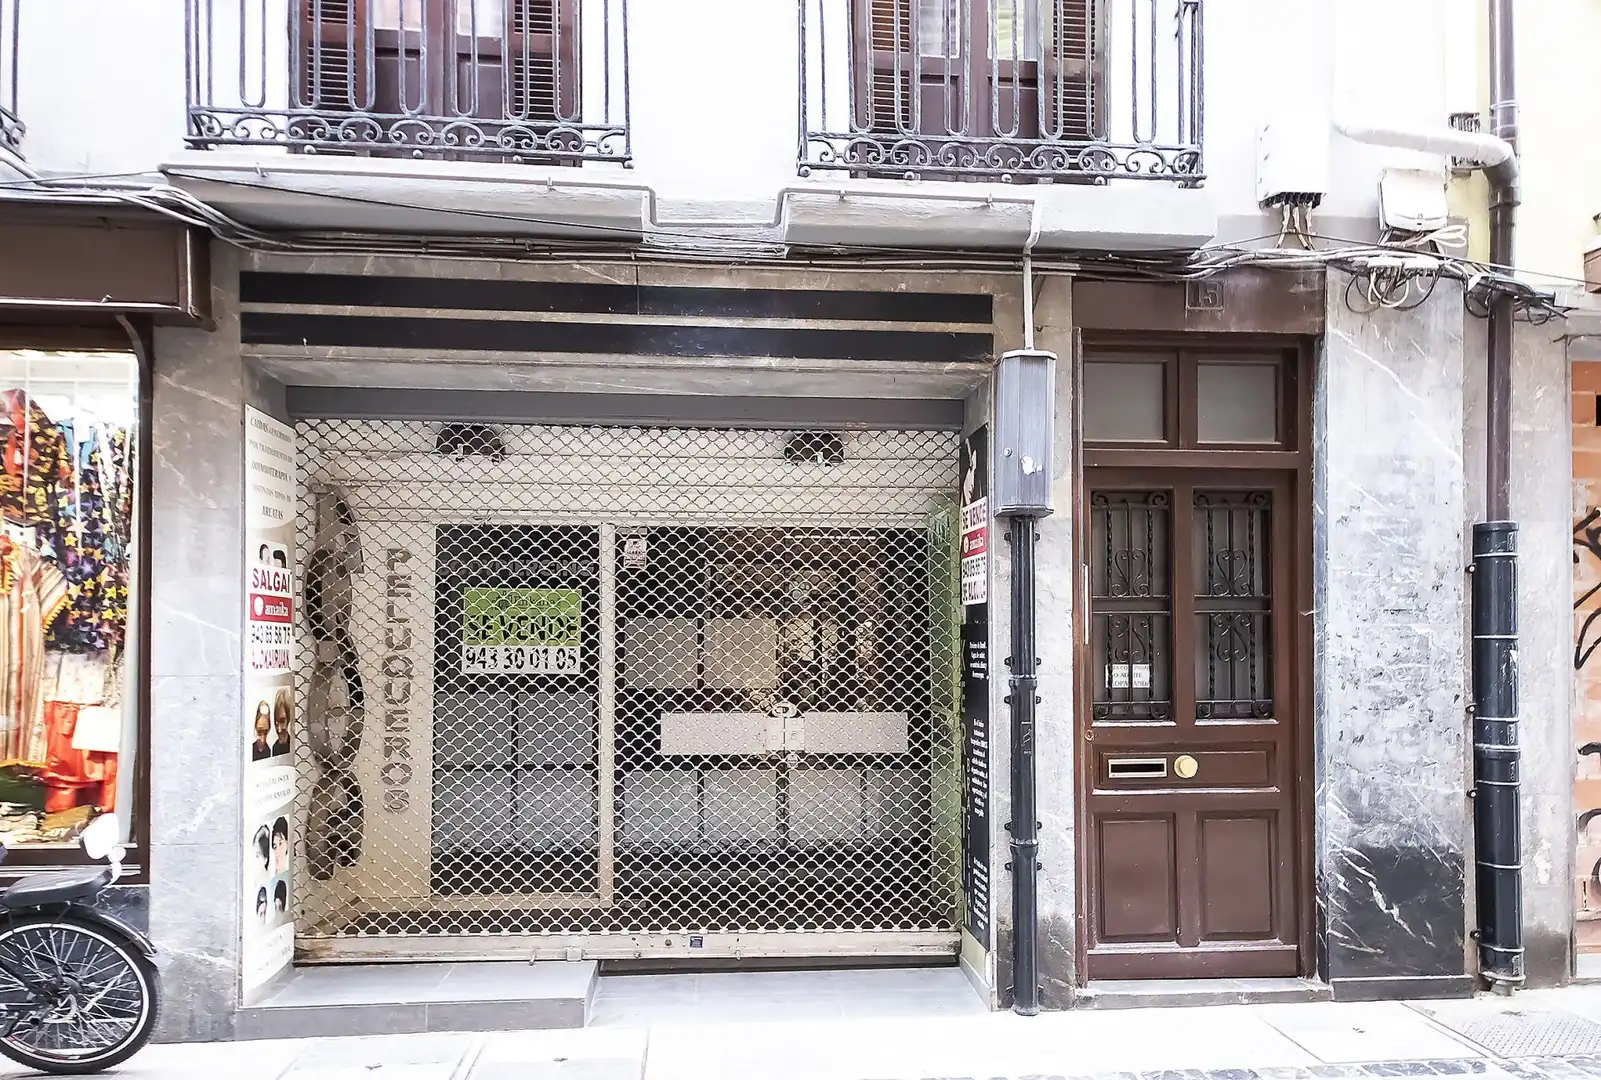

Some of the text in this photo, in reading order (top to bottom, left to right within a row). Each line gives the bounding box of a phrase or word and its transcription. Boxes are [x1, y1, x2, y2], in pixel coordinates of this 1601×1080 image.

[467, 615, 578, 641] SE VENDE
[465, 646, 577, 669] 943 30 01 05
[381, 548, 414, 814] PELUQUEROS
